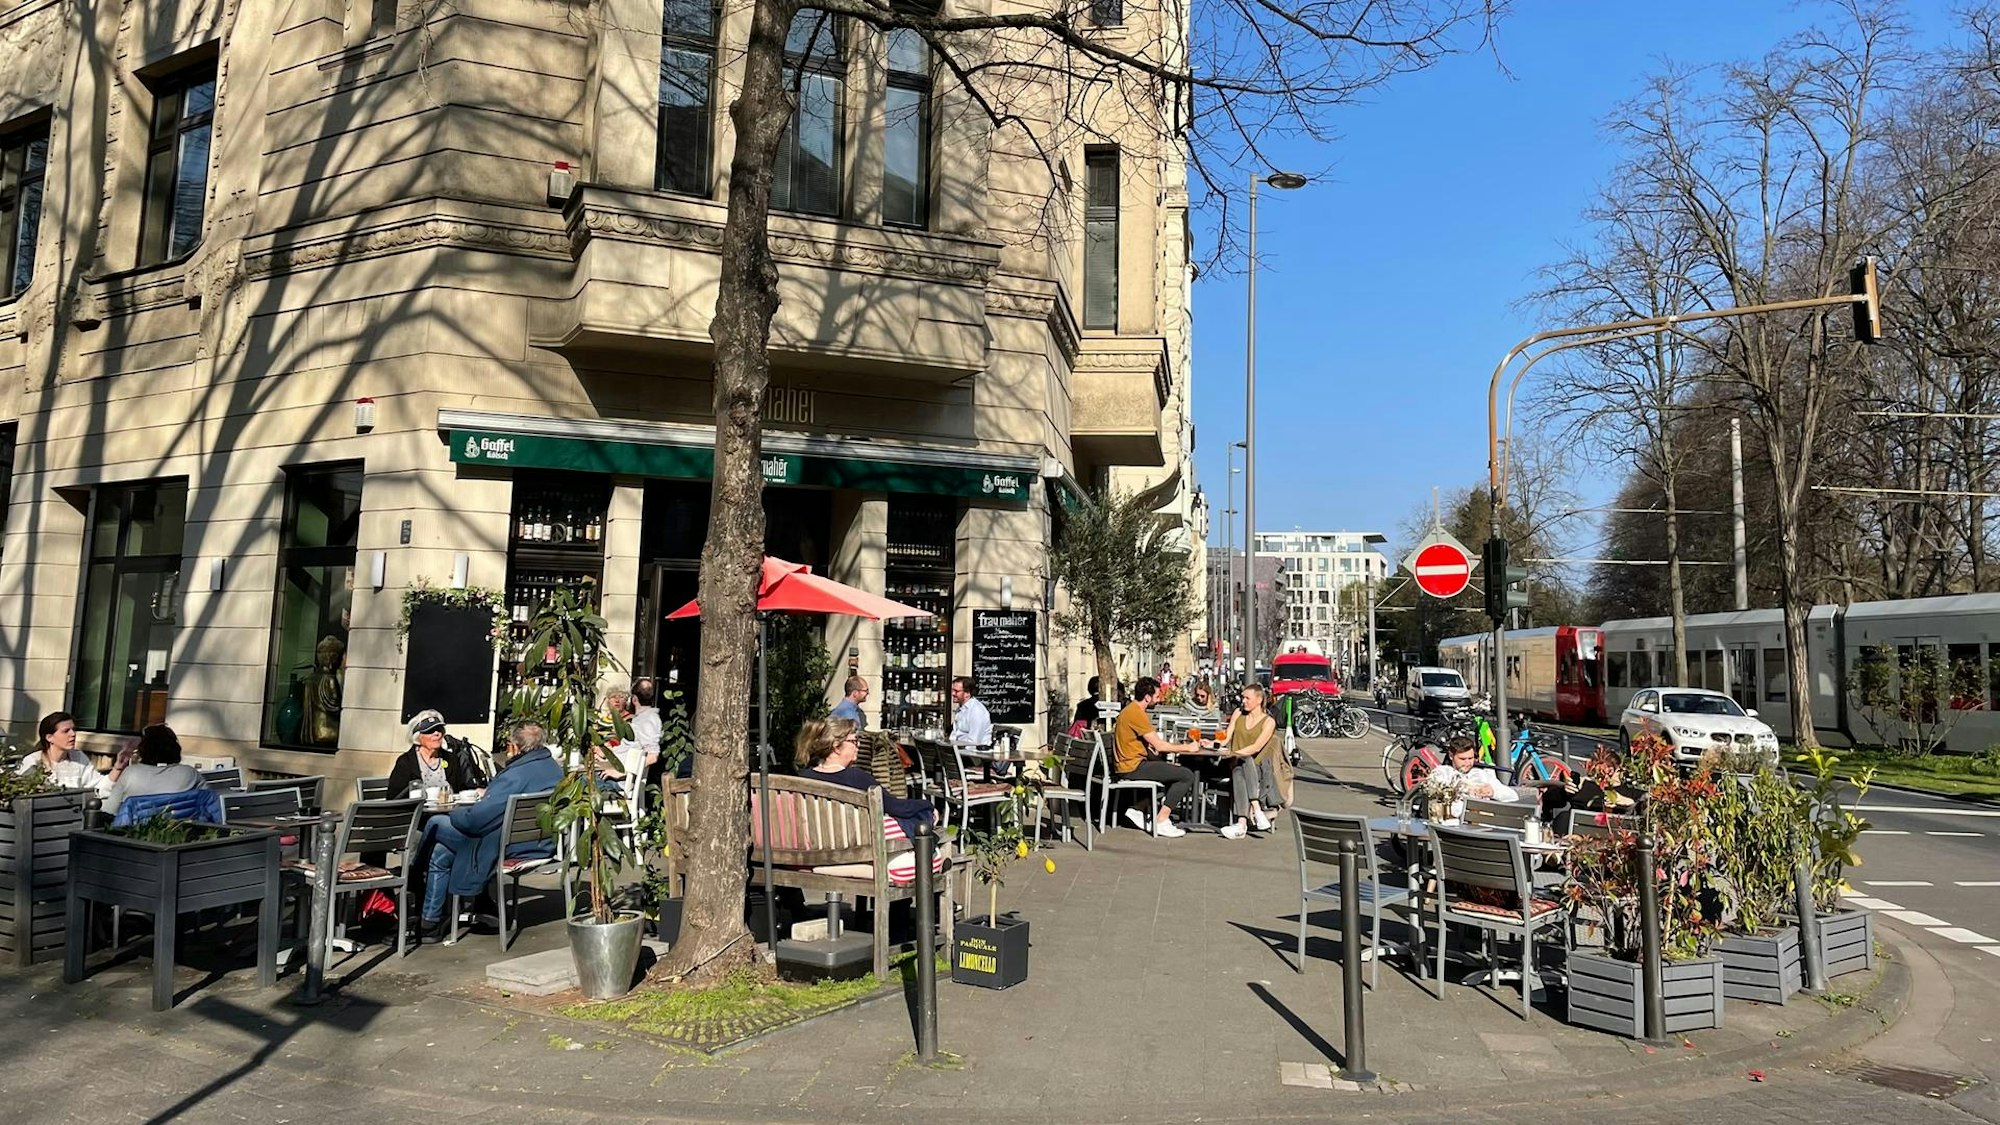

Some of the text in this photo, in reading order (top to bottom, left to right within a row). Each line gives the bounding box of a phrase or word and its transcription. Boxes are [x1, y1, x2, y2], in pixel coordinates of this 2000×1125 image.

[481, 437, 515, 452] Gaffel
[486, 450, 509, 460] Kölsch
[994, 475, 1020, 488] Gaffel
[978, 612, 998, 627] frau
[959, 940, 997, 952] PASQUALE
[971, 937, 986, 946] DON
[959, 951, 997, 974] LIMONCELLO
